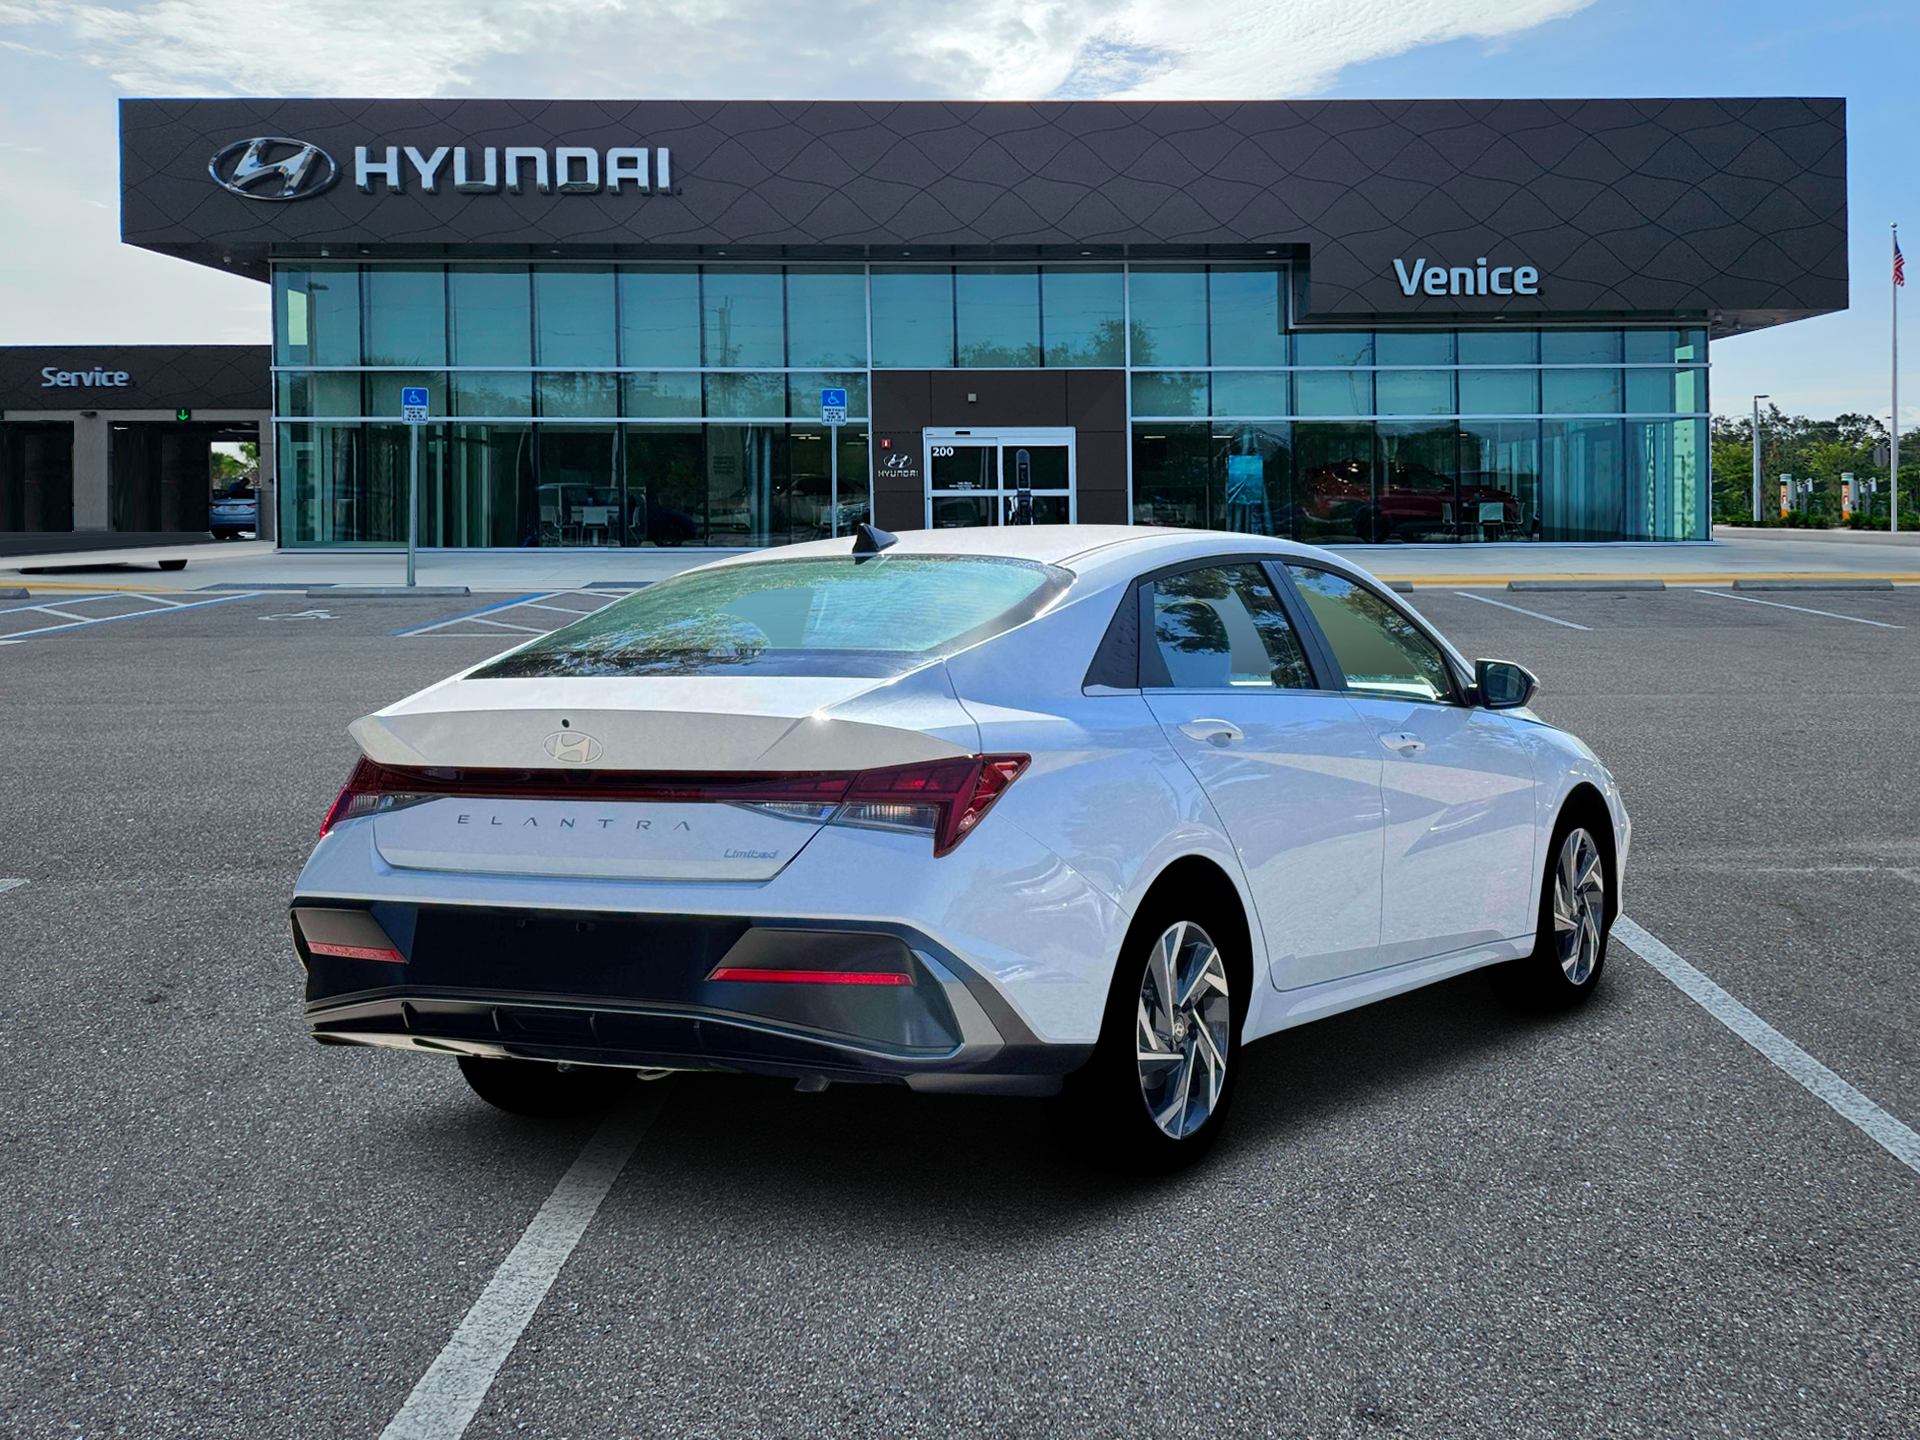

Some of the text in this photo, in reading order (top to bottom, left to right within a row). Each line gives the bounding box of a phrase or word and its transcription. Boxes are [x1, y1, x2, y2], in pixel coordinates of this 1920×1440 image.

[354, 146, 672, 194] HYUNDAI
[1393, 256, 1539, 296] Venice
[41, 366, 130, 388] Service
[932, 446, 954, 457] 200
[878, 469, 919, 478] HYUNDAI
[457, 814, 691, 832] ELANTRA
[723, 848, 780, 859] Limited
